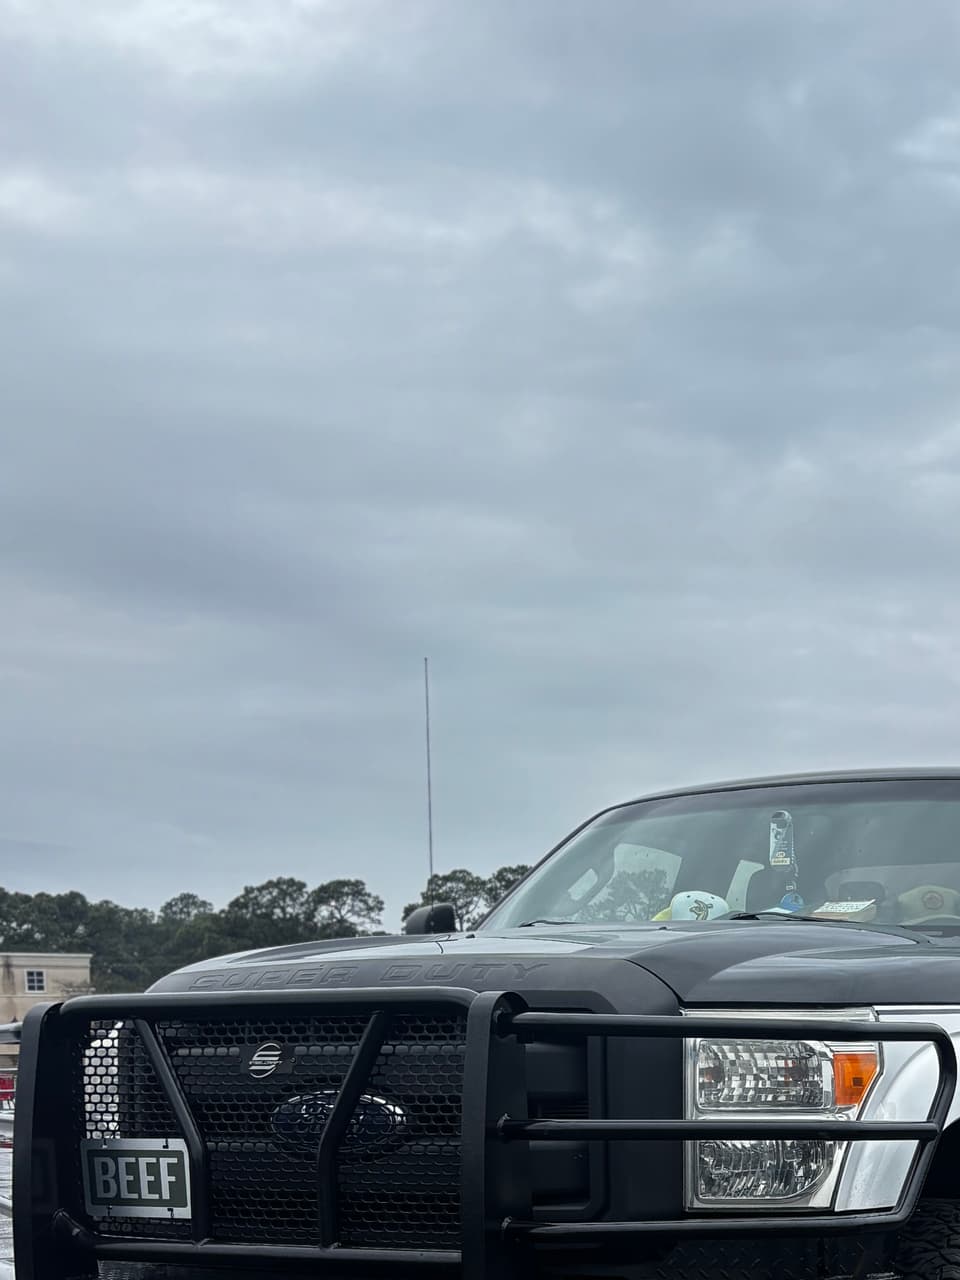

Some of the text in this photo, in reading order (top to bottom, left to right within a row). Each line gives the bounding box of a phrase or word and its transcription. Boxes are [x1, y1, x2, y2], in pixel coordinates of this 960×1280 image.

[188, 962, 549, 991] SUPER DUTY
[93, 1156, 178, 1200] BEEF
